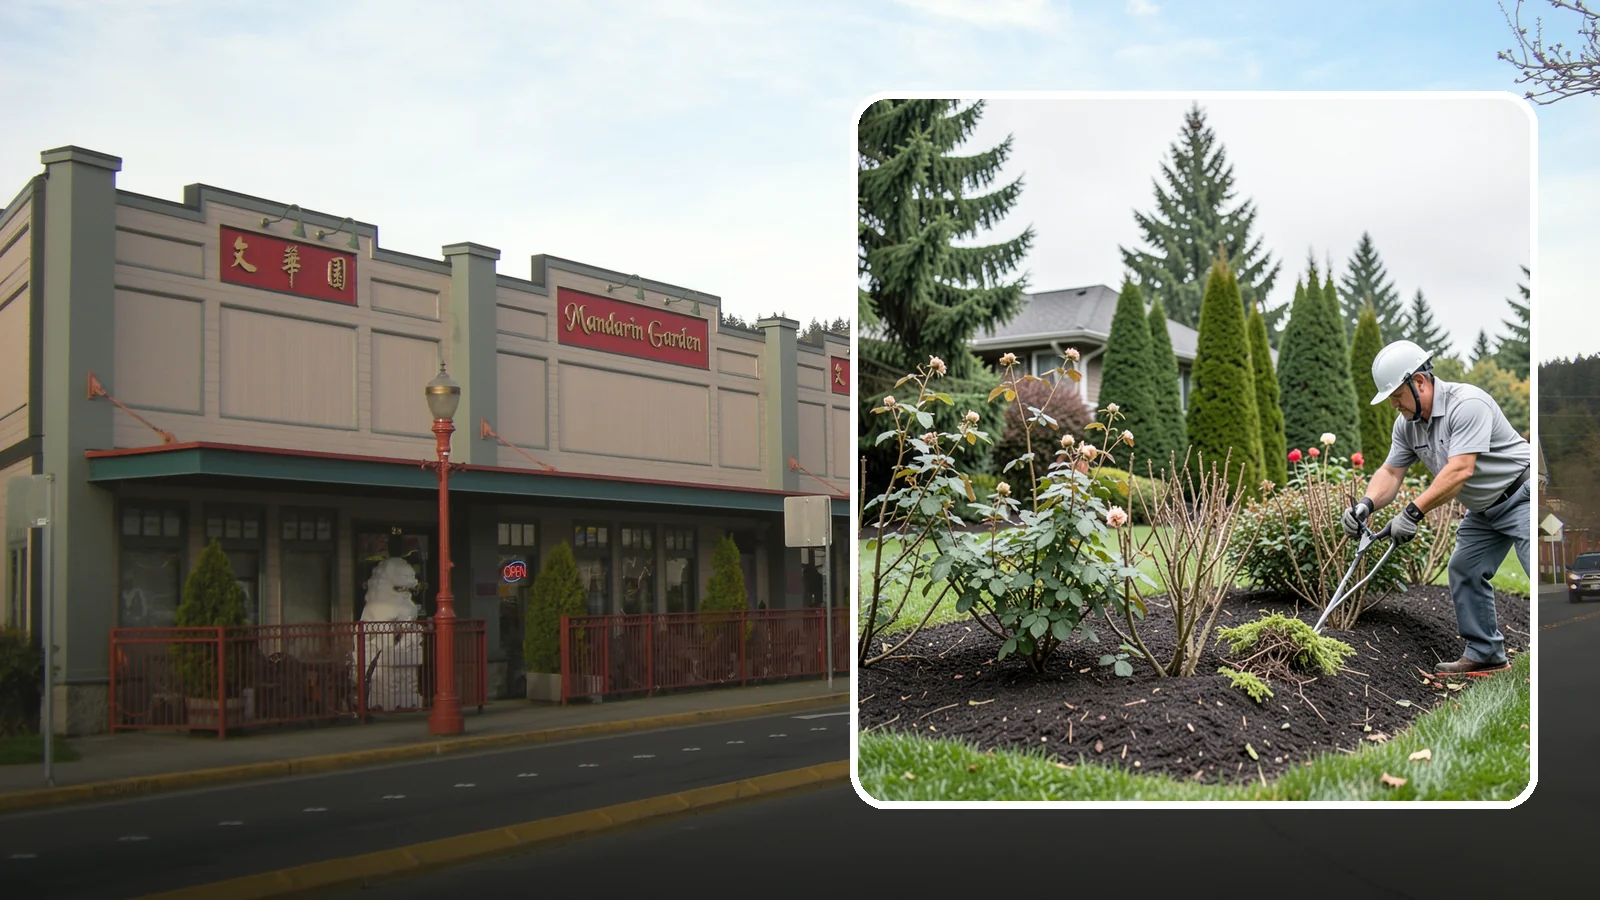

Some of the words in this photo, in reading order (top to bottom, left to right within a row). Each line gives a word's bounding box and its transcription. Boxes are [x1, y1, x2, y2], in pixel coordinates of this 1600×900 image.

[230, 235, 346, 291] 文華園
[564, 302, 644, 341] Mandarin
[648, 320, 702, 352] Garden
[503, 565, 527, 578] OPEN
